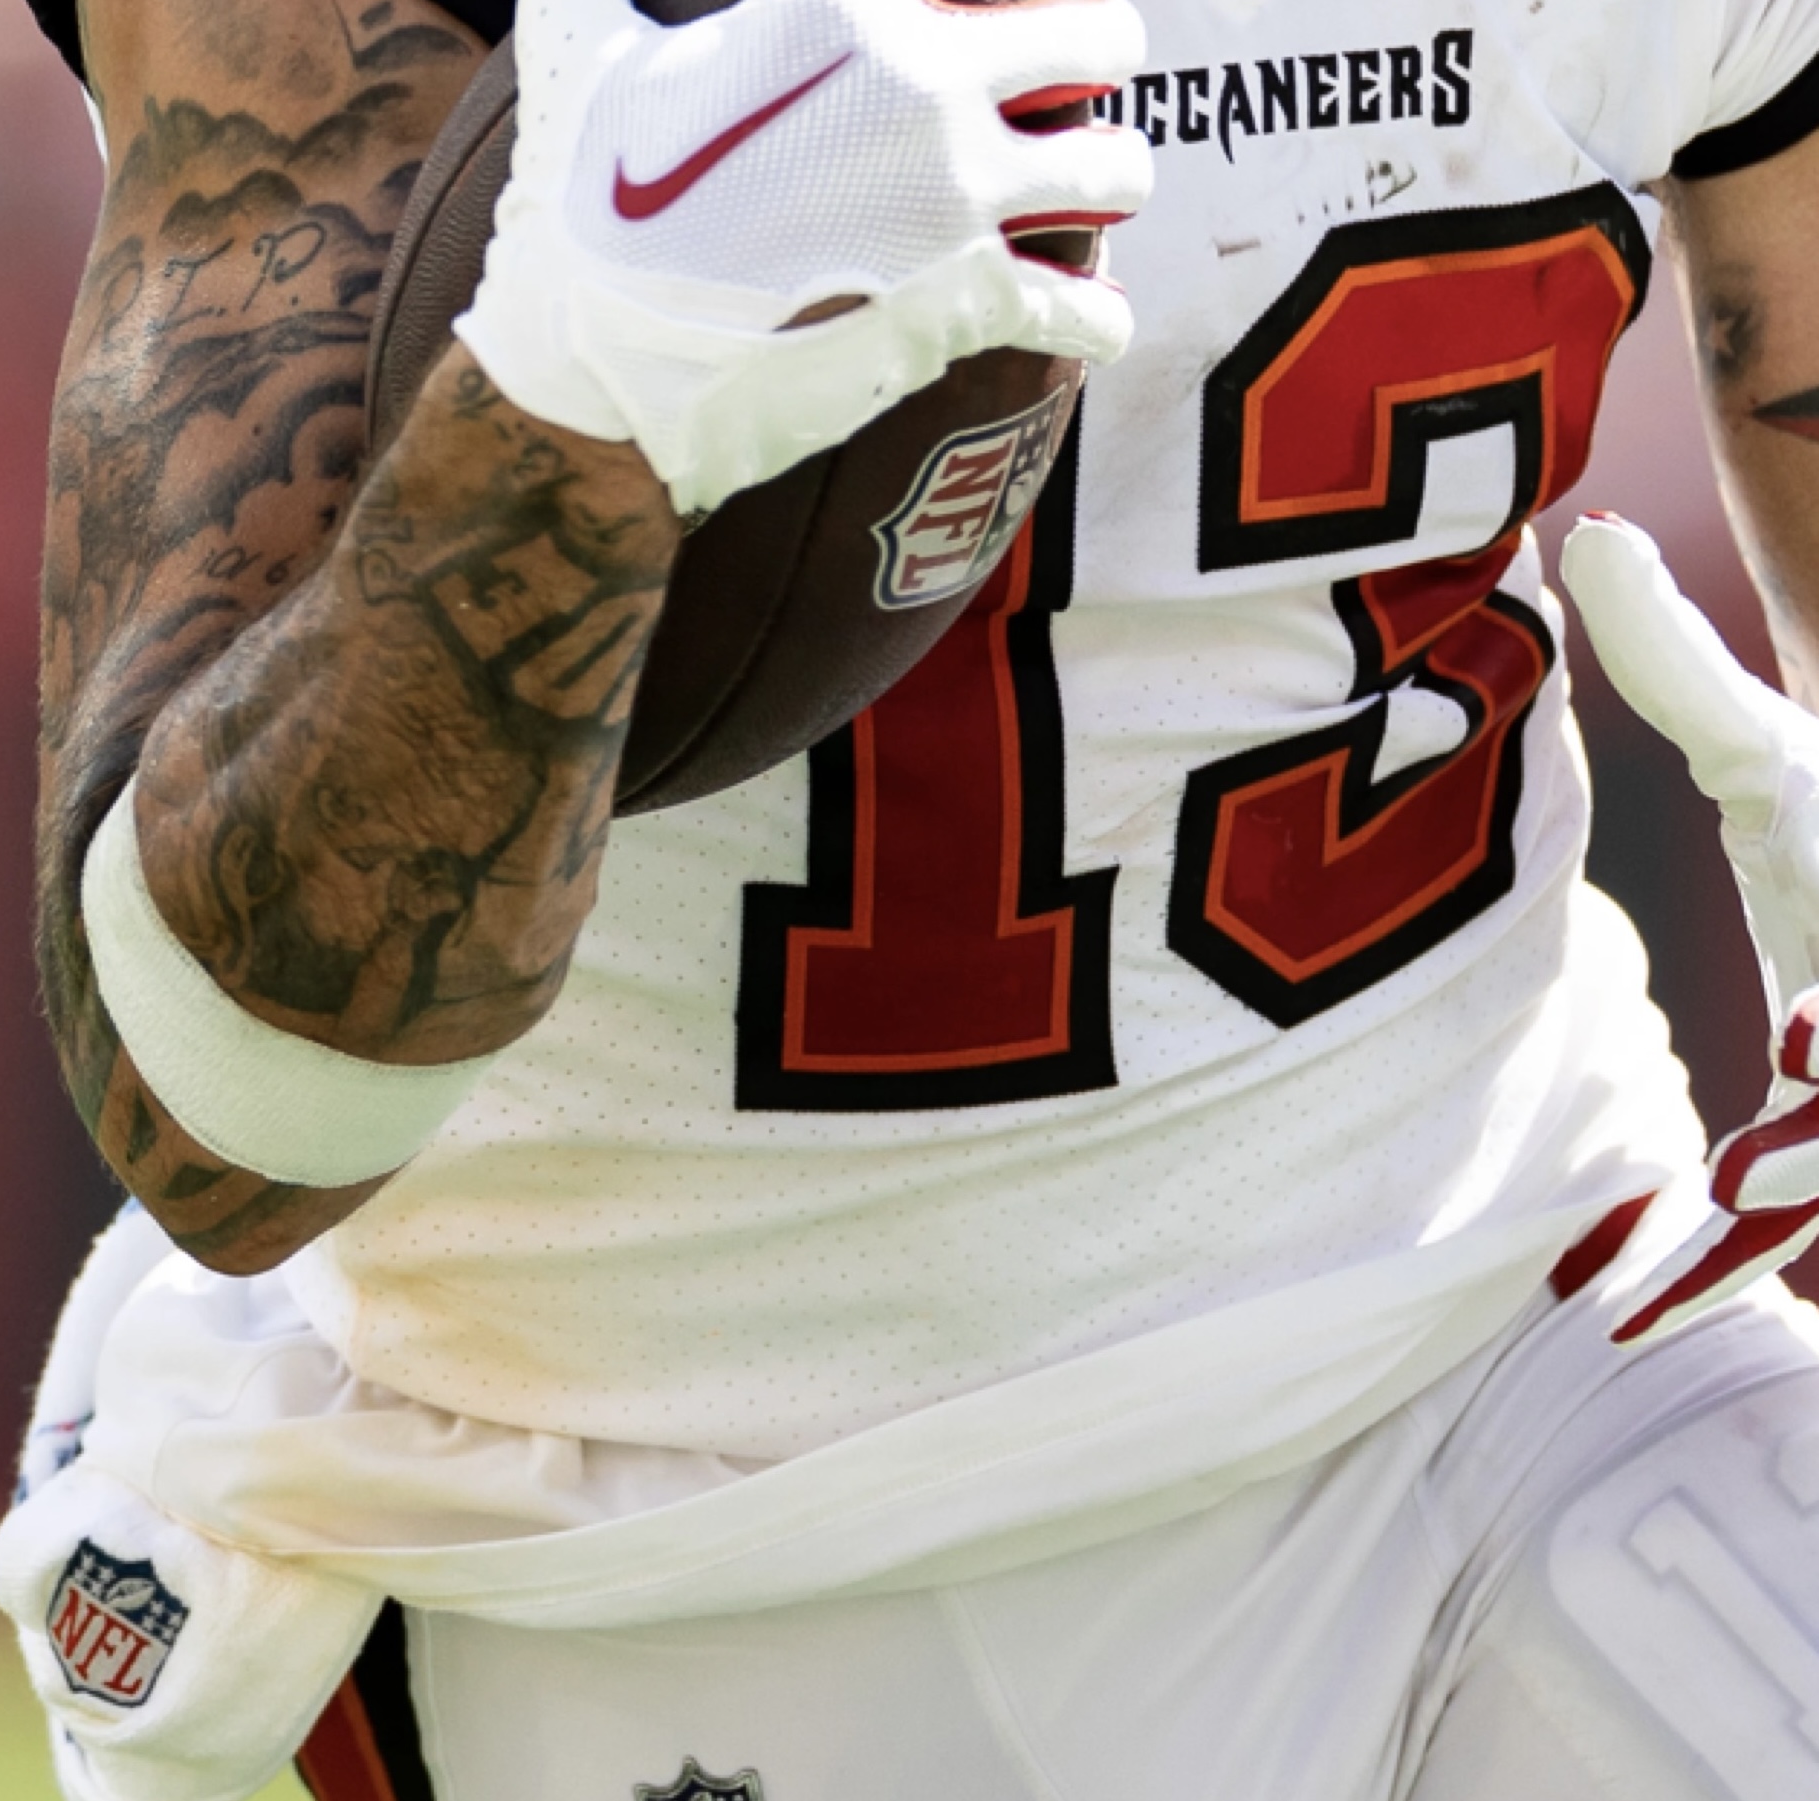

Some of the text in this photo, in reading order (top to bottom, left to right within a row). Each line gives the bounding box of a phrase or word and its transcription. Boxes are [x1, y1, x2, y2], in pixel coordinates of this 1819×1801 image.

[899, 437, 1015, 593] NFL
[735, 180, 1652, 1113] 13
[51, 1586, 152, 1697] NFL
